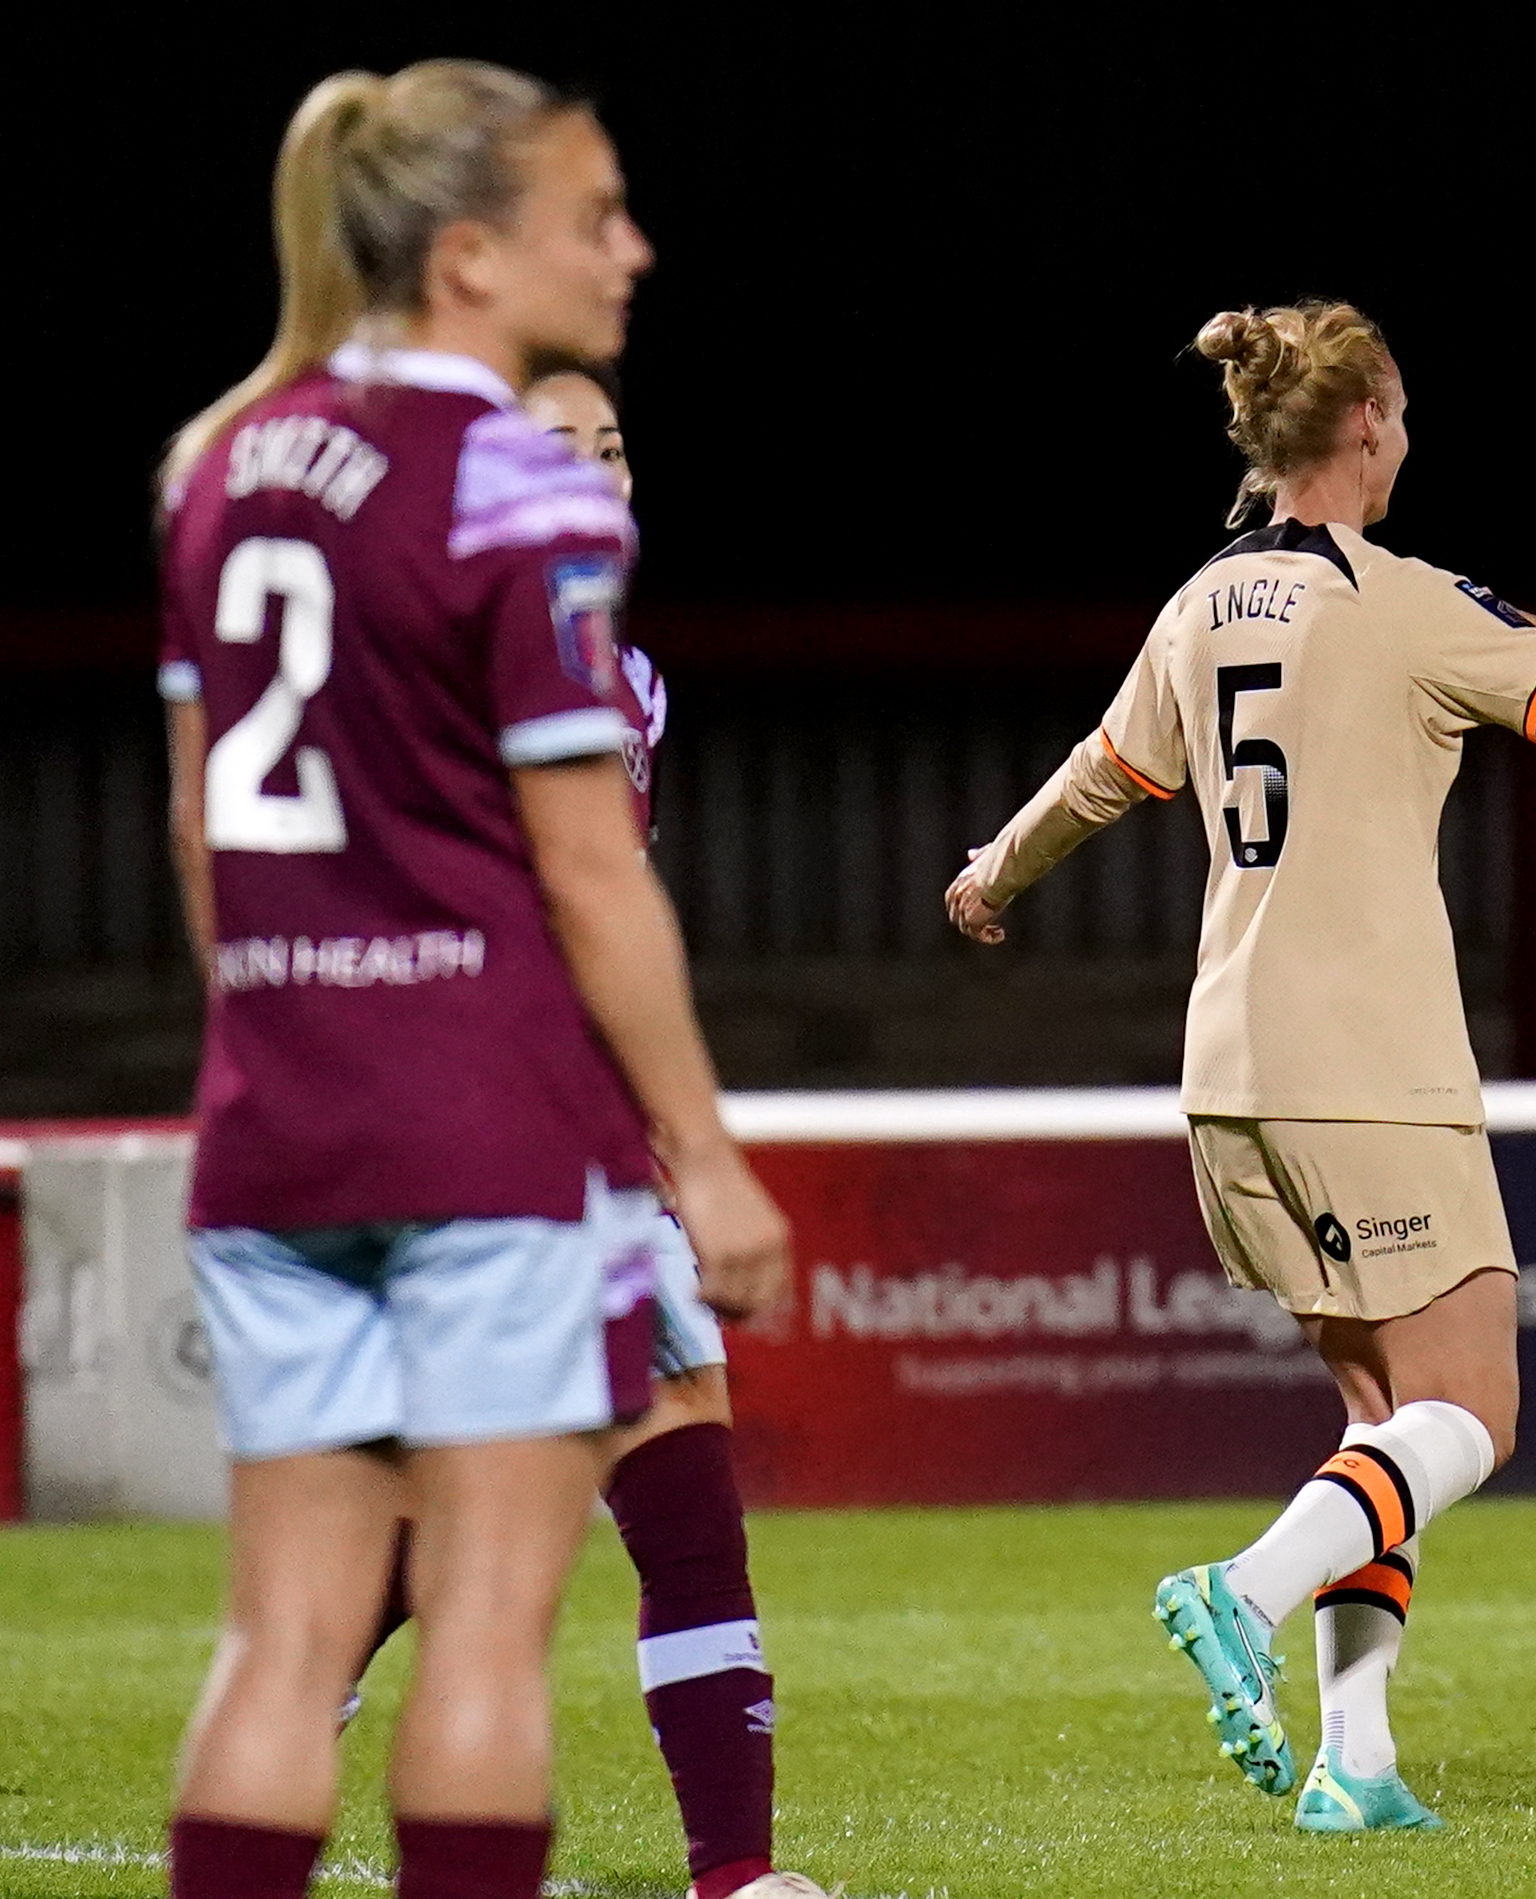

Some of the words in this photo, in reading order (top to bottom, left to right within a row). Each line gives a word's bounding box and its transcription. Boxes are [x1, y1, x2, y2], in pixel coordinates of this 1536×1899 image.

[1208, 578, 1306, 631] INGLE
[204, 536, 349, 853] 2
[1216, 661, 1290, 869] 5
[292, 927, 486, 988] HEALTH
[1356, 1213, 1432, 1241] Singer
[1361, 1245, 1397, 1259] Capital
[1397, 1238, 1438, 1254] Markets
[809, 1255, 1121, 1339] National
